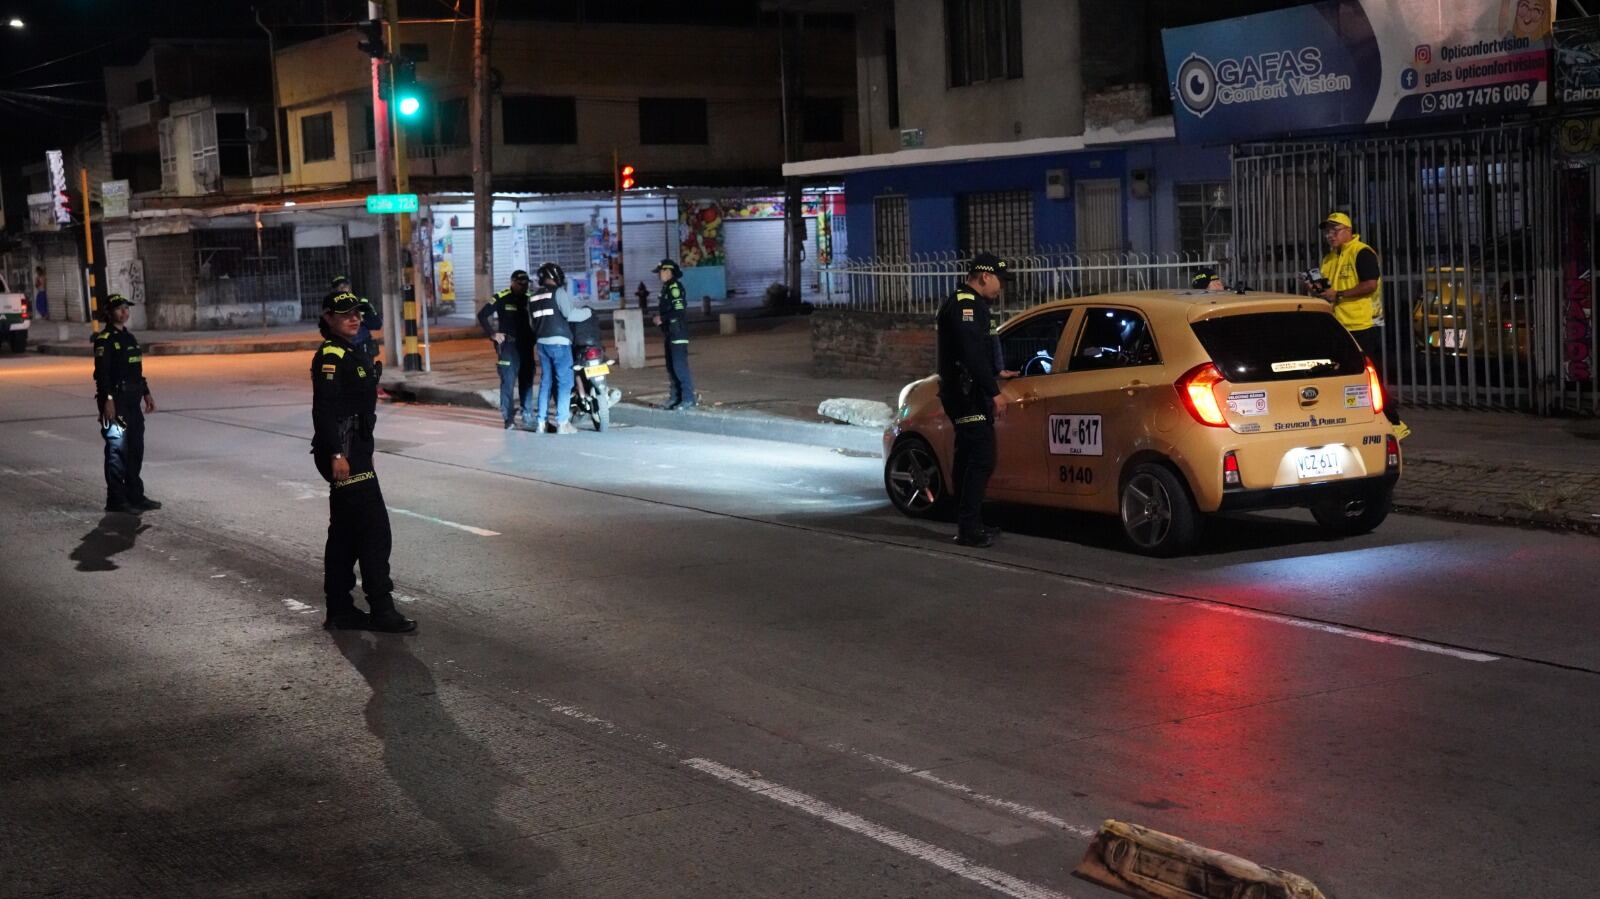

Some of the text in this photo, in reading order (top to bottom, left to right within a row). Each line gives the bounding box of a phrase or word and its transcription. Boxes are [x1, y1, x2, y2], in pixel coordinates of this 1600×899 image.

[1441, 37, 1530, 62] Opticonfortvision
[1217, 46, 1322, 86] GAFAS
[1425, 69, 1453, 87] gafas
[1219, 73, 1352, 104] Confort Visión
[1439, 83, 1530, 111] 302 7476 006
[1051, 418, 1099, 445] VCZ 617
[1297, 452, 1339, 471] VCZ 617
[1060, 465, 1092, 485] 8140
